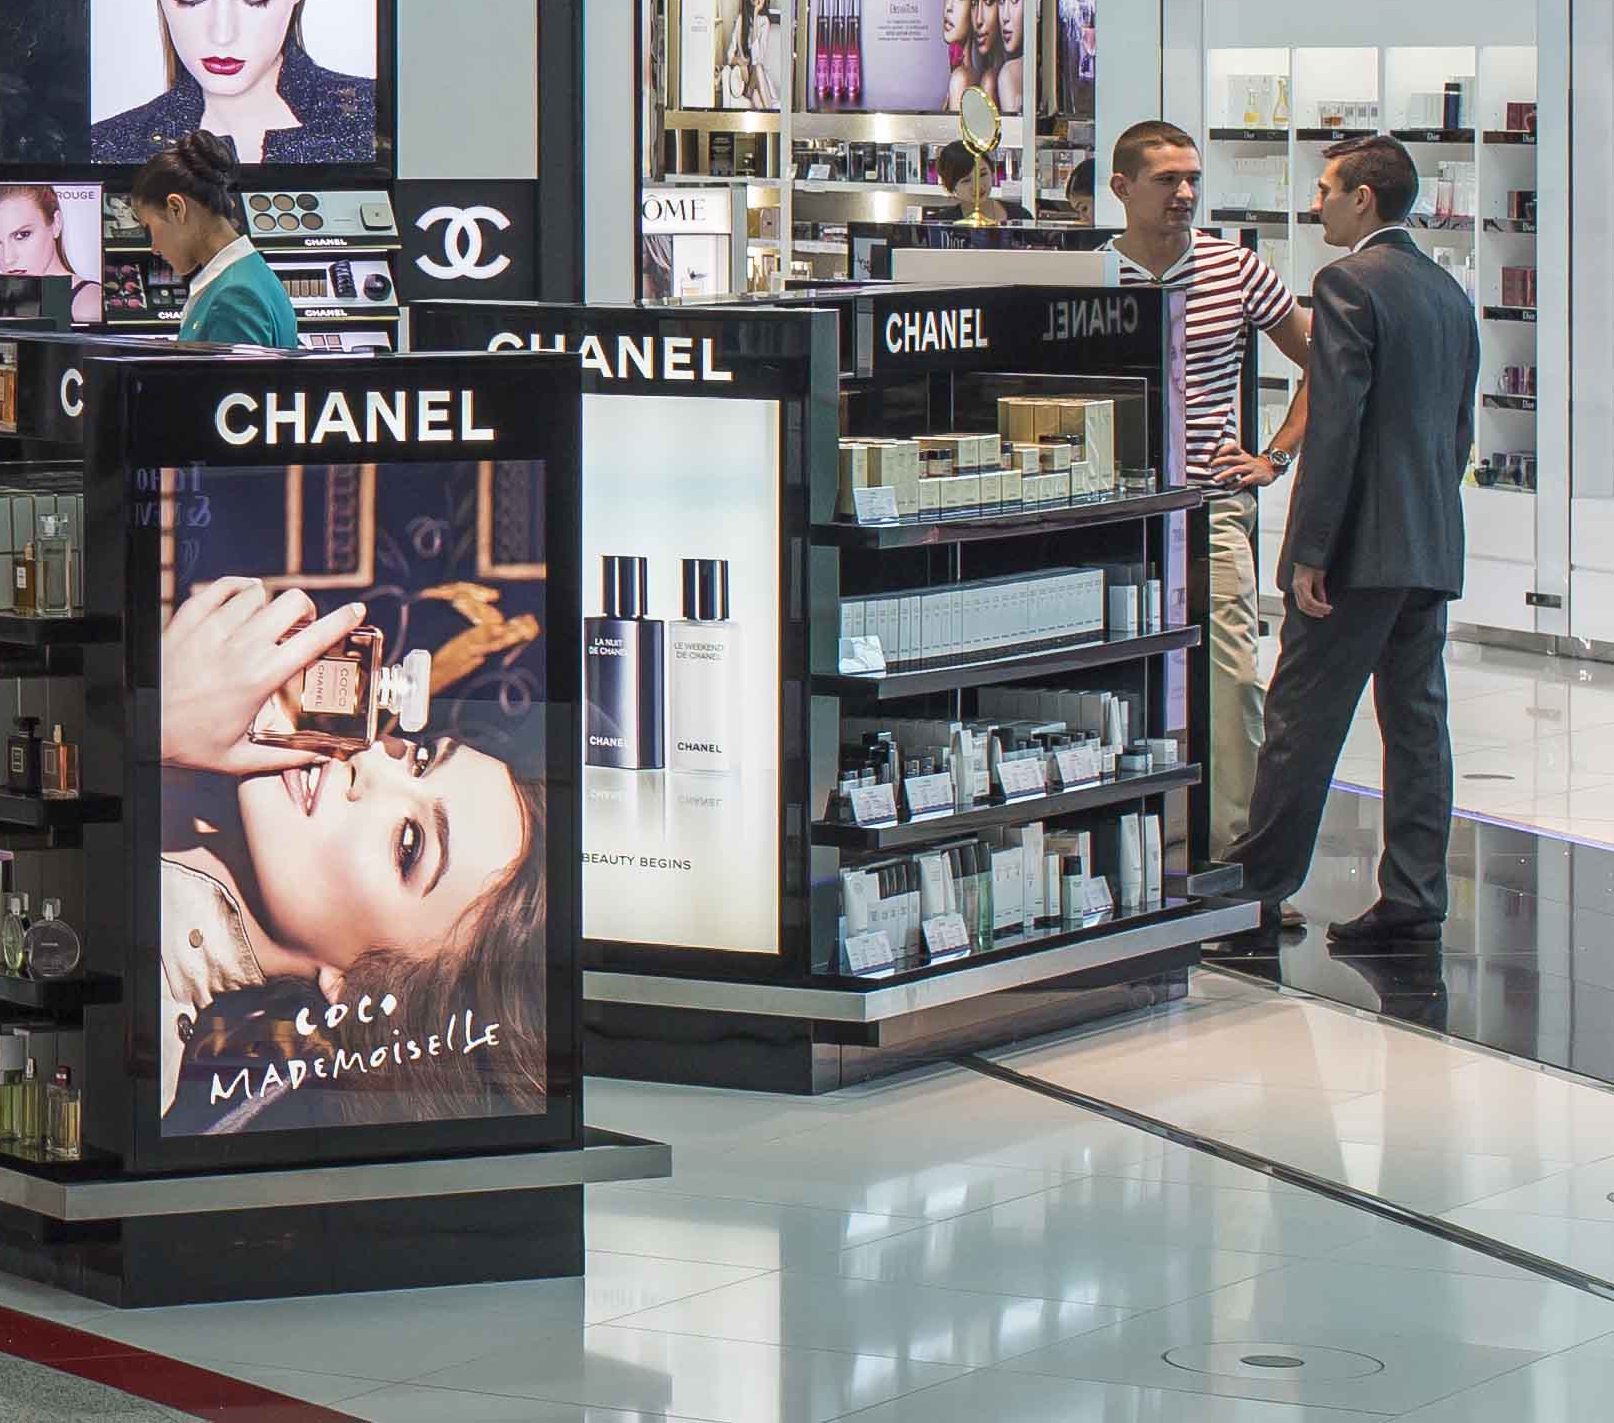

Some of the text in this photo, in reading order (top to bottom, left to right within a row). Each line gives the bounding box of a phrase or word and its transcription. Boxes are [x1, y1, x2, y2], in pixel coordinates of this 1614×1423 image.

[305, 238, 348, 247] CHANEL
[940, 230, 966, 248] Dior
[305, 309, 348, 318] CHANEL
[886, 308, 988, 354] CHANEL
[214, 390, 495, 445] CHANEL
[594, 638, 605, 646] LA
[675, 642, 685, 650] LE
[589, 646, 599, 655] DE
[677, 742, 723, 754] CHANEL
[583, 852, 692, 871] BEAUTY BEGINS
